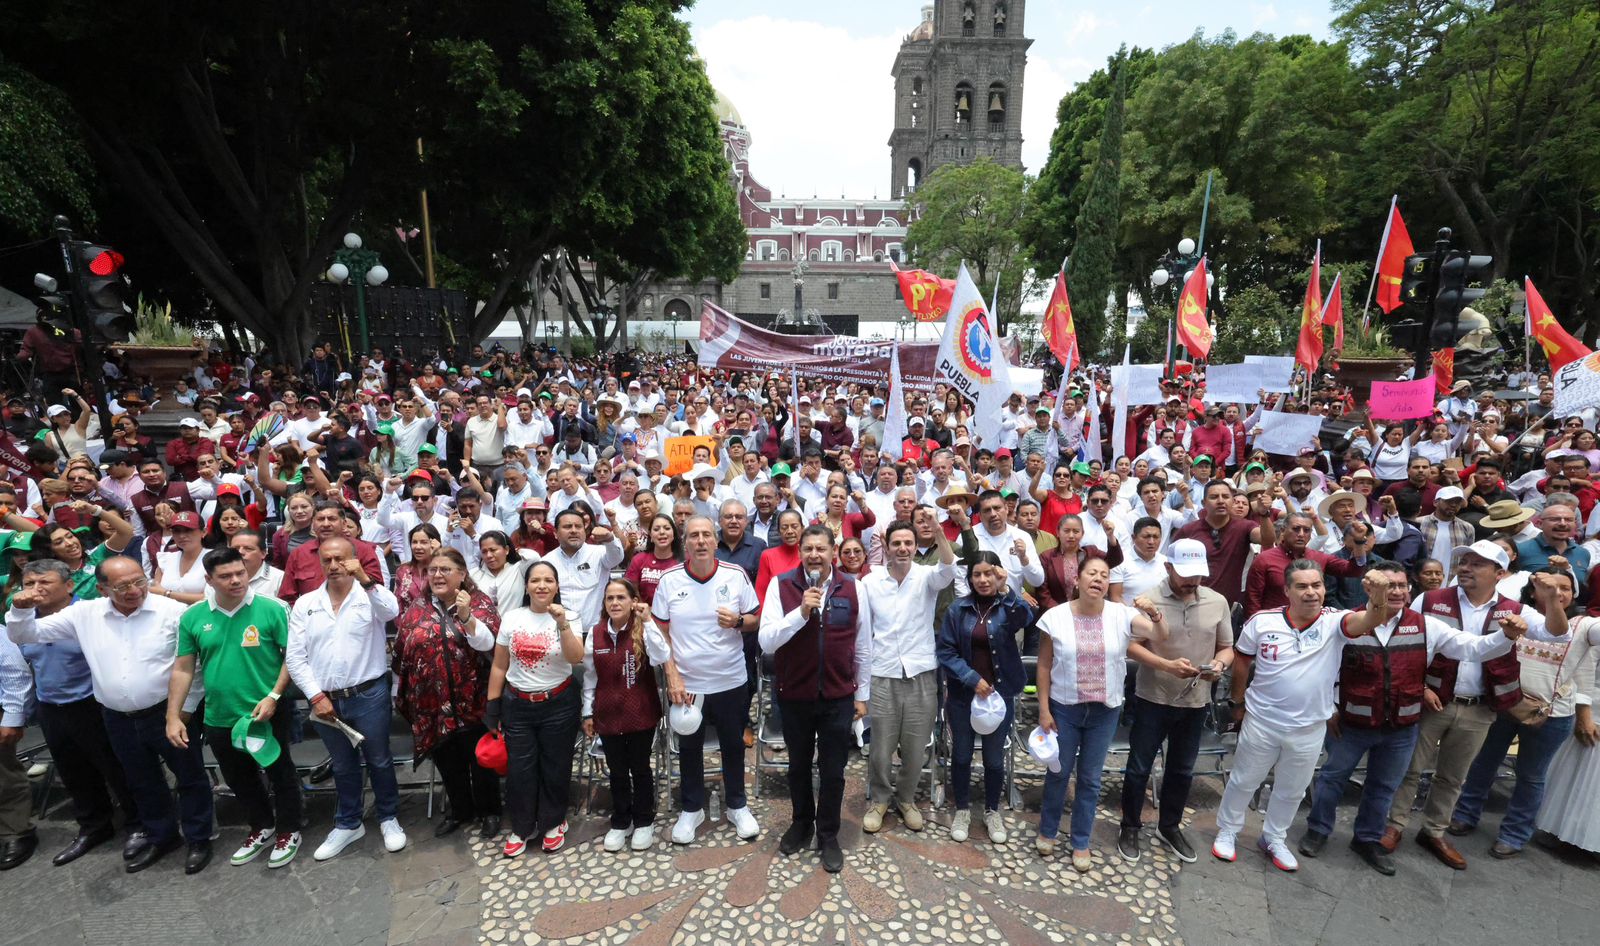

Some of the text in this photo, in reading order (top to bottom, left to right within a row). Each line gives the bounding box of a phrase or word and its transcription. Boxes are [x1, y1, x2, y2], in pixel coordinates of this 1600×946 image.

[1413, 261, 1424, 273] 19
[911, 283, 941, 311] PT
[813, 343, 891, 359] morena
[730, 353, 742, 361] LAS
[842, 368, 879, 378] PRESIDENTA
[904, 374, 932, 382] CLAUDIA
[940, 358, 980, 403] PUEBLA
[1261, 642, 1279, 662] 27
[629, 654, 637, 685] morena
